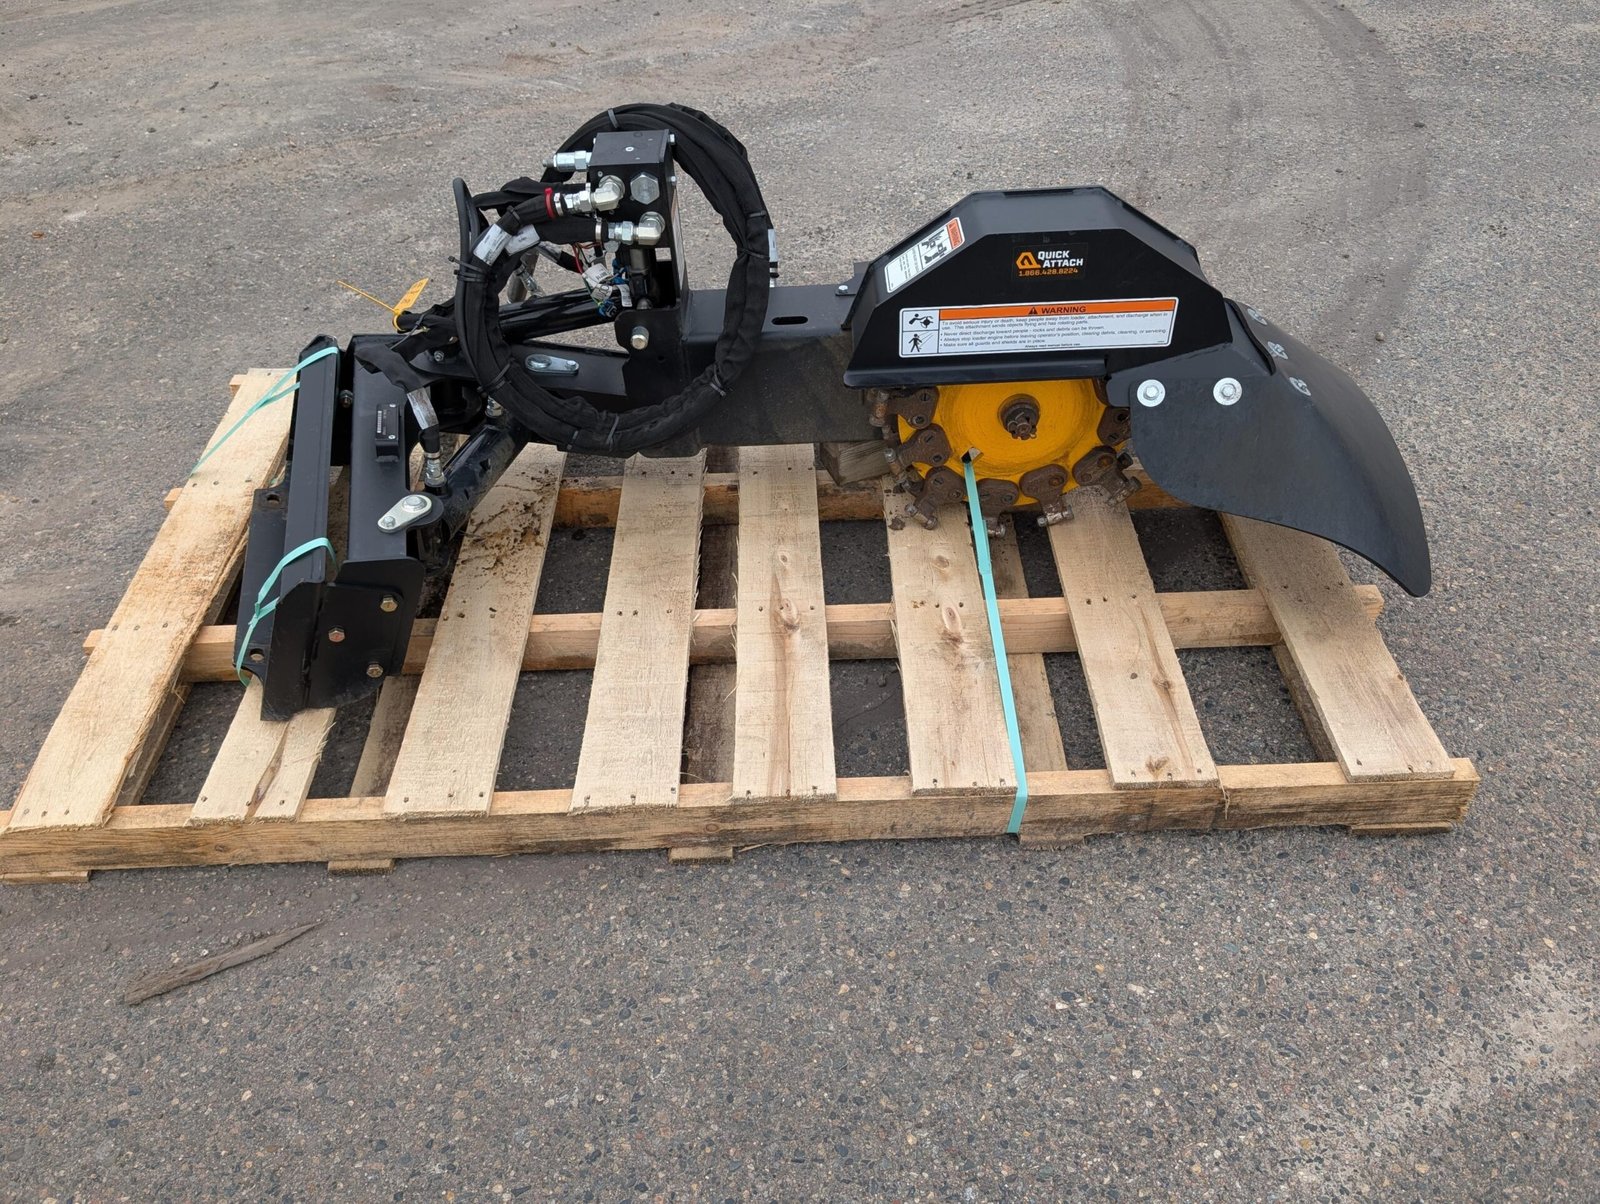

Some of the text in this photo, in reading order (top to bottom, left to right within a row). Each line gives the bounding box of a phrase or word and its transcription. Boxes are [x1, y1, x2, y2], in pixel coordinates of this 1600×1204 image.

[1038, 250, 1070, 260] QUICK
[1042, 258, 1083, 268] ATTACH
[1019, 268, 1078, 277] 1.866.428.8224
[1041, 306, 1086, 314] WARNING
